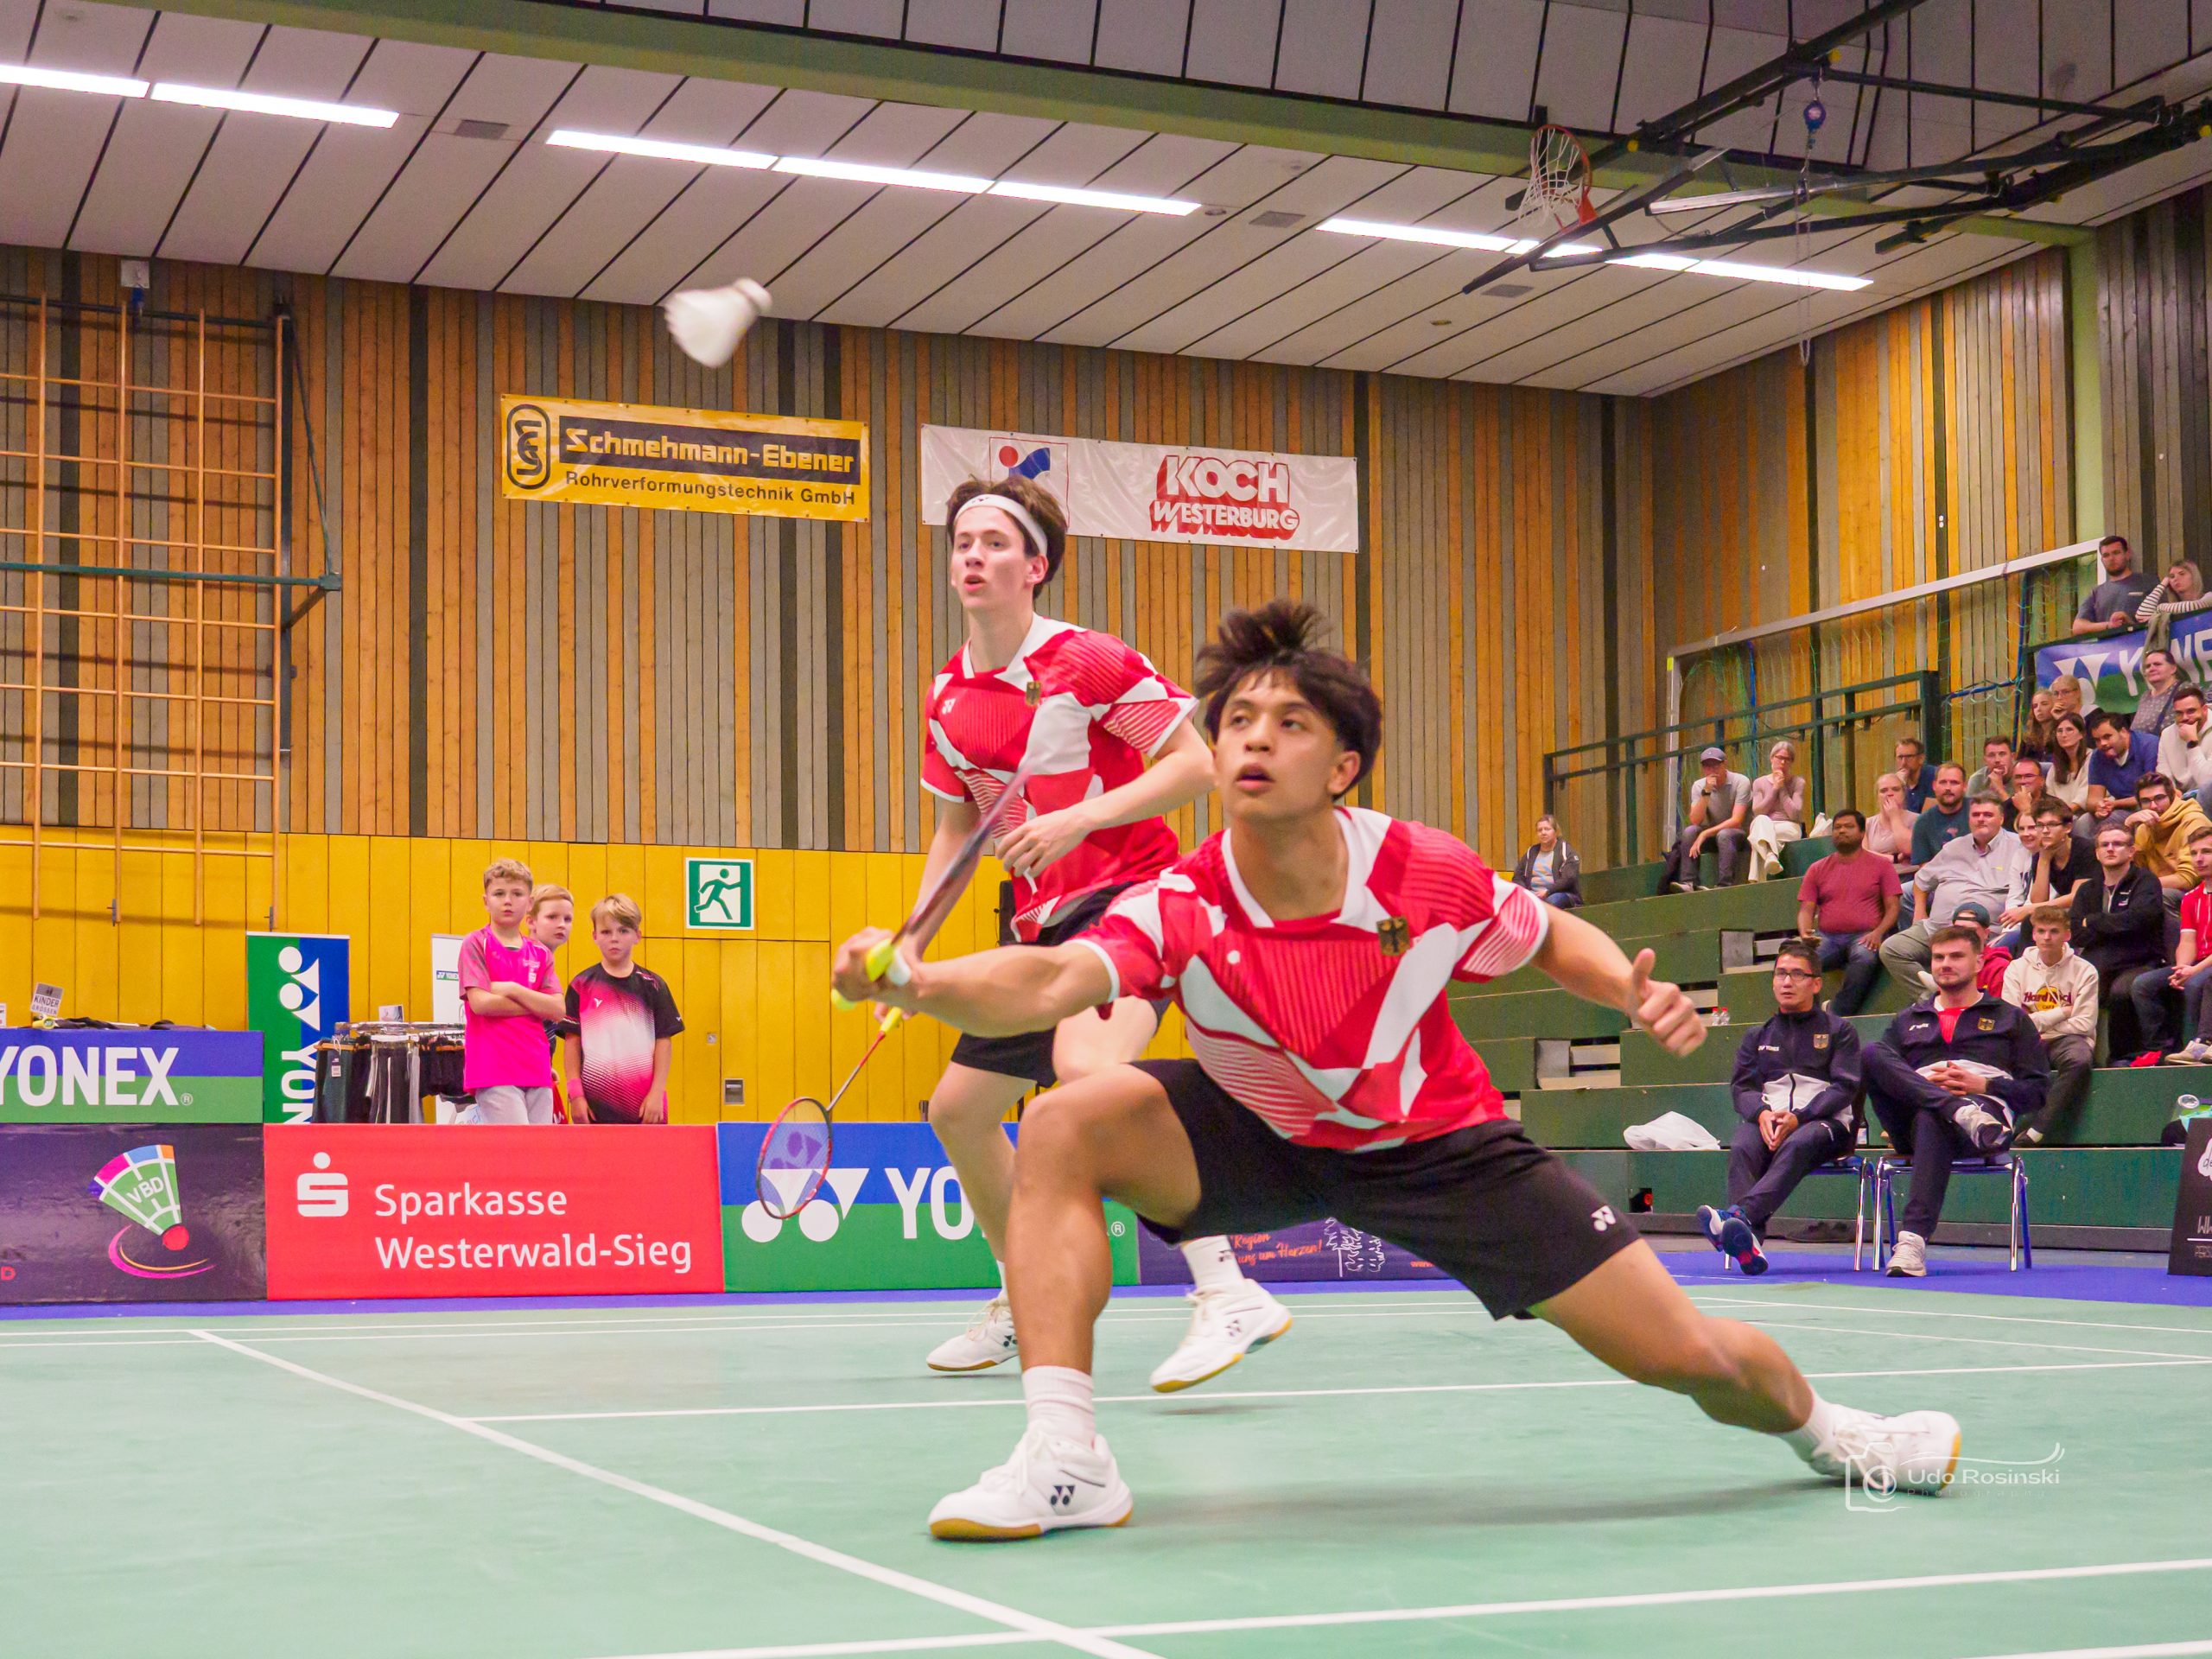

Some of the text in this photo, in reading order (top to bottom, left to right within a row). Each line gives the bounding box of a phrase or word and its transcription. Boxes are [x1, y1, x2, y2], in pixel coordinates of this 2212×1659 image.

[565, 428, 854, 473] Schmehmann-Ebener
[566, 471, 855, 505] Rohrverformungstechnik GmbH
[1159, 454, 1289, 504] KOCH
[1152, 499, 1300, 537] WESTERBURG
[34, 995, 60, 1007] KINDER
[126, 1176, 166, 1204] VBD
[374, 1183, 568, 1224] Sparkasse
[375, 1234, 691, 1274] Westerwald-Sieg
